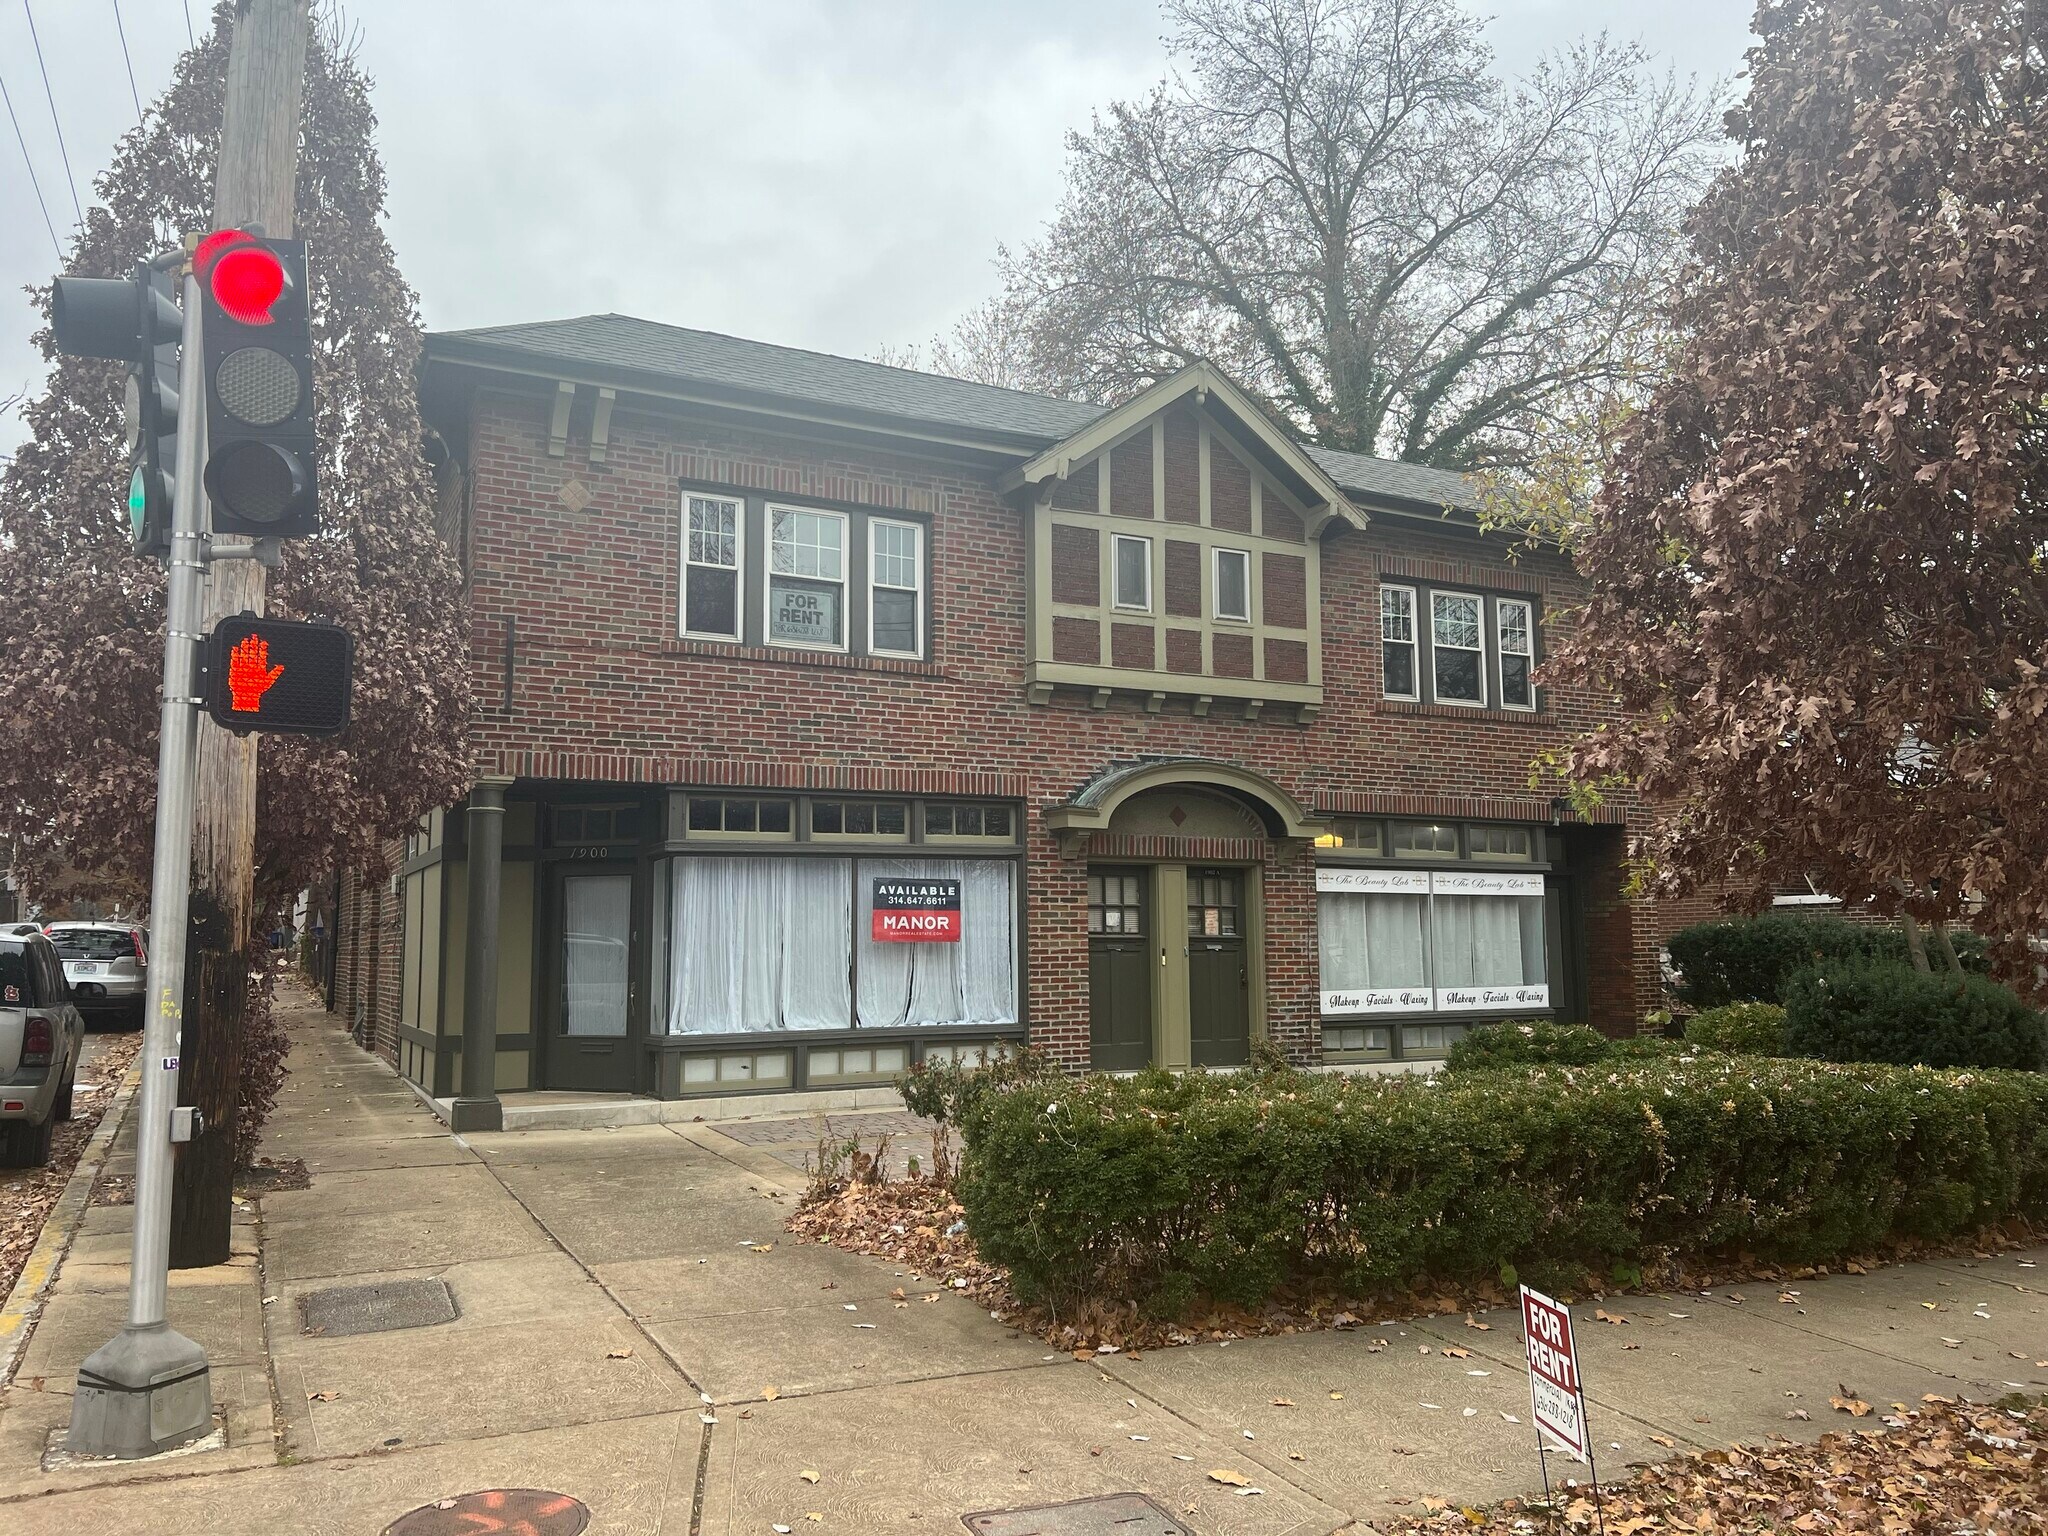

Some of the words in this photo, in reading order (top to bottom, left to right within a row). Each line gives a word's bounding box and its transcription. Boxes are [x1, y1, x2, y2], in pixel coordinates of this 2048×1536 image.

[786, 594, 817, 609] FOR
[780, 608, 823, 625] RENT
[1336, 874, 1352, 884] The
[1355, 875, 1388, 888] Beauty
[1391, 876, 1409, 886] Lab
[1452, 878, 1469, 888] The
[1471, 878, 1504, 891] Beauty
[1507, 878, 1524, 889] Lab
[879, 886, 955, 896] AVAILABLE
[888, 896, 946, 905] 314.647.6611
[884, 916, 949, 929] MANOR
[1329, 995, 1360, 1008] Makeup
[1366, 993, 1393, 1007] Facials
[1399, 992, 1428, 1006] Waxing
[1446, 992, 1476, 1005] Makeup
[1482, 991, 1509, 1003] Facials
[1515, 989, 1544, 1003] Waxing
[1530, 1302, 1563, 1348] FOR
[1529, 1335, 1571, 1387] RENT
